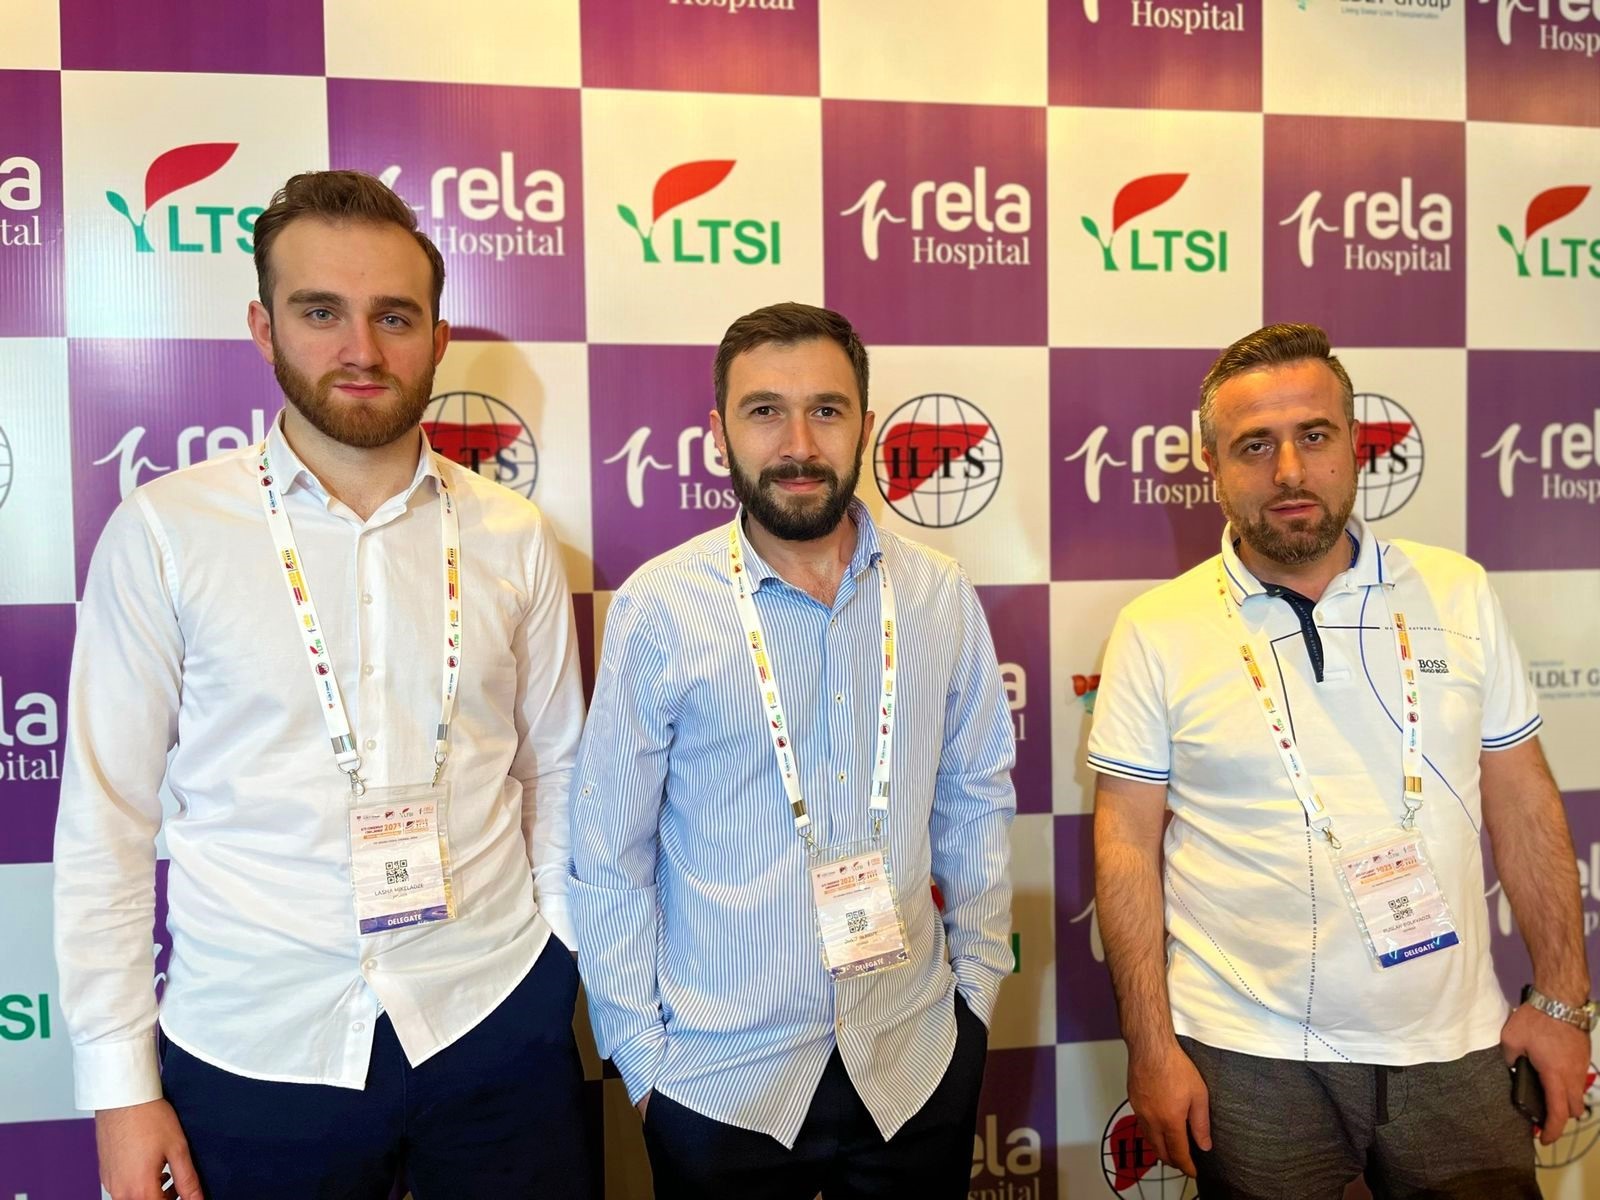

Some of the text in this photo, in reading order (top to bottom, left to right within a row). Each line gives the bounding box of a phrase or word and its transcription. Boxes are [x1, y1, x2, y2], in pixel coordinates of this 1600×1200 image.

[1131, 0, 1244, 35] Hospital
[1540, 24, 1600, 58] Hosp
[431, 151, 566, 223] rela
[911, 166, 1031, 233] rela
[1344, 177, 1452, 241] rela
[433, 226, 565, 262] Hospital
[673, 219, 780, 265] LTSI
[913, 236, 1031, 270] Hospital
[1131, 229, 1228, 273] LTSI
[1345, 243, 1451, 276] Hospital
[1132, 409, 1210, 473] rel
[889, 445, 986, 479] ILTS
[1418, 659, 1448, 669] BOSS
[387, 914, 422, 926] DELEGATE
[855, 958, 884, 971] DELEGATE
[1404, 942, 1435, 958] DELEGATE
[0, 994, 51, 1041] SI
